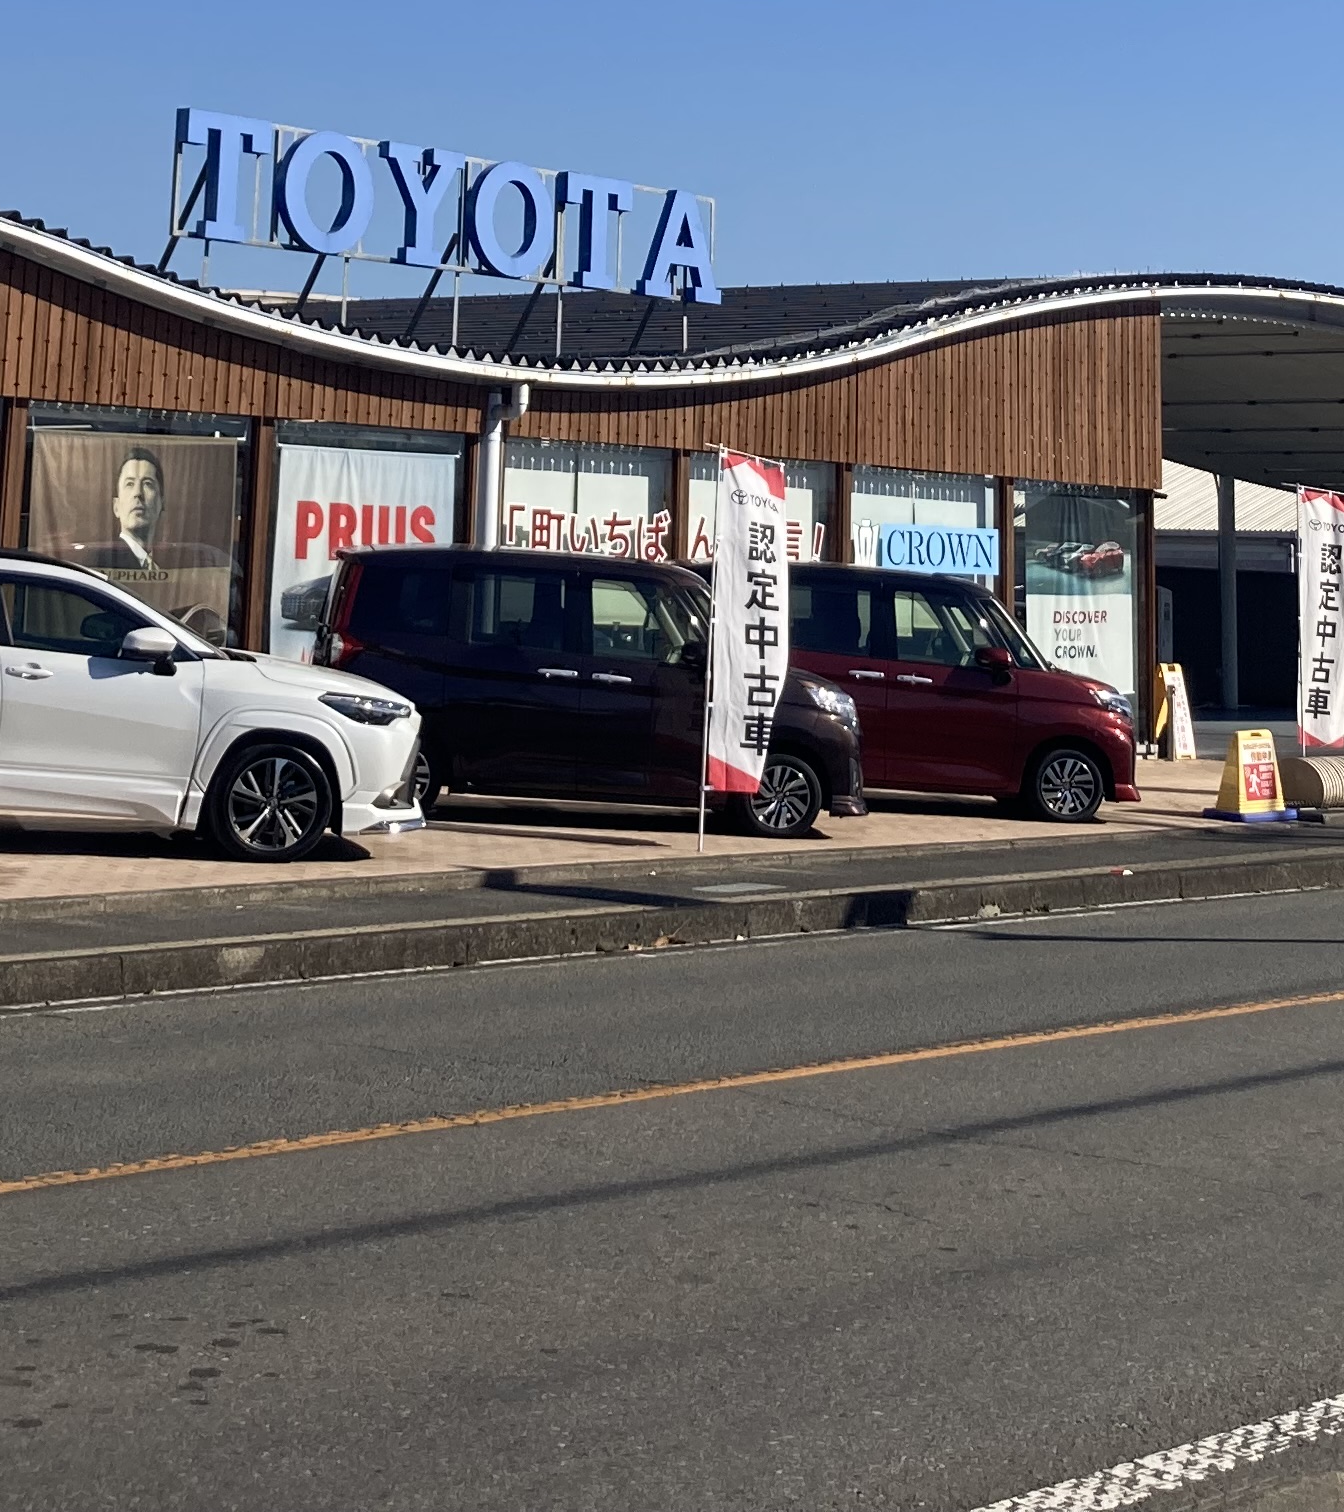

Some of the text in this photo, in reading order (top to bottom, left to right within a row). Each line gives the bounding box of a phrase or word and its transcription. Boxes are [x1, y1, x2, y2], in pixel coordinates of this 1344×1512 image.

[175, 107, 722, 304] TOYOTA
[886, 529, 995, 569] CROWN
[739, 521, 780, 756] 認定中古車
[1053, 610, 1108, 624] DISCOVER
[1054, 627, 1082, 642] YOUR
[1304, 543, 1343, 719] 認定中古車
